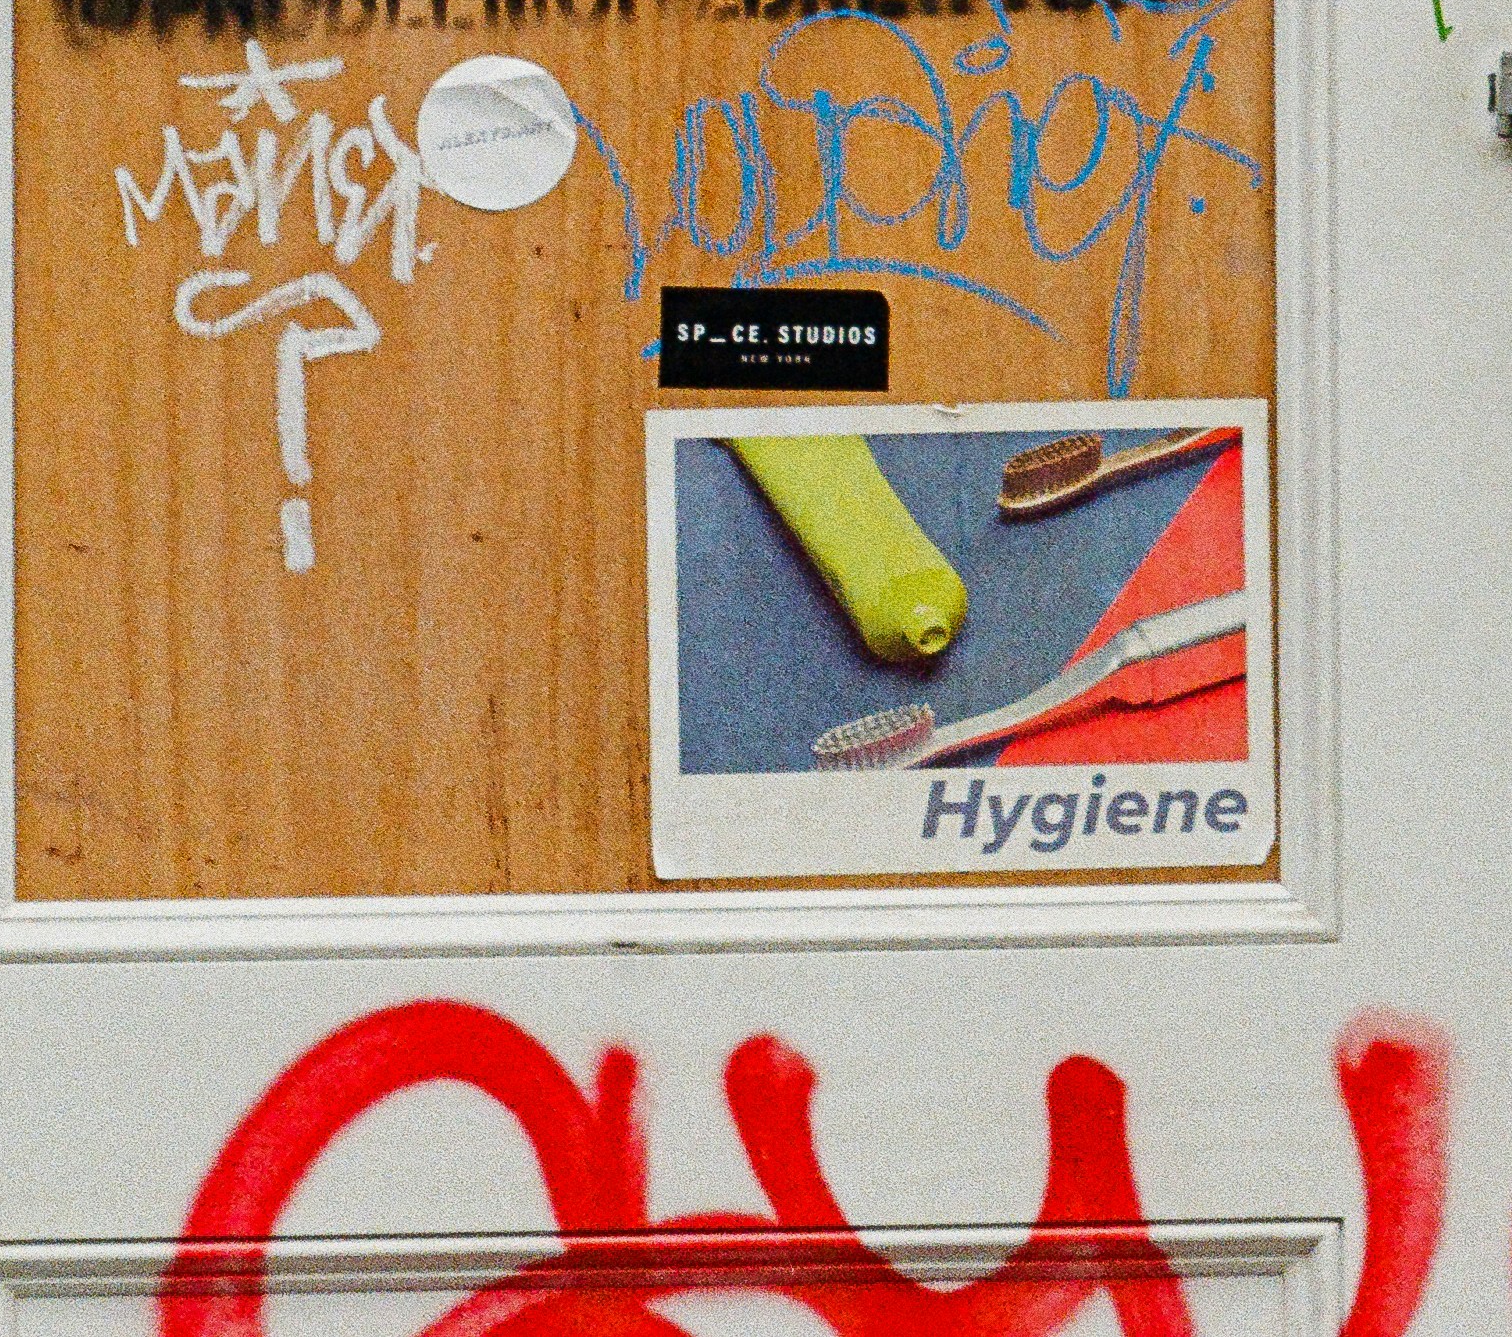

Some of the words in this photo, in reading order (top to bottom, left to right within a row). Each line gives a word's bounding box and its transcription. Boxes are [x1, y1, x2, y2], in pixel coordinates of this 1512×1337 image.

[676, 322, 769, 345] SP_CE.
[777, 324, 878, 346] STUDIOS
[740, 353, 770, 364] NEW
[776, 354, 812, 365] YORK
[920, 773, 1250, 856] Hygiene
